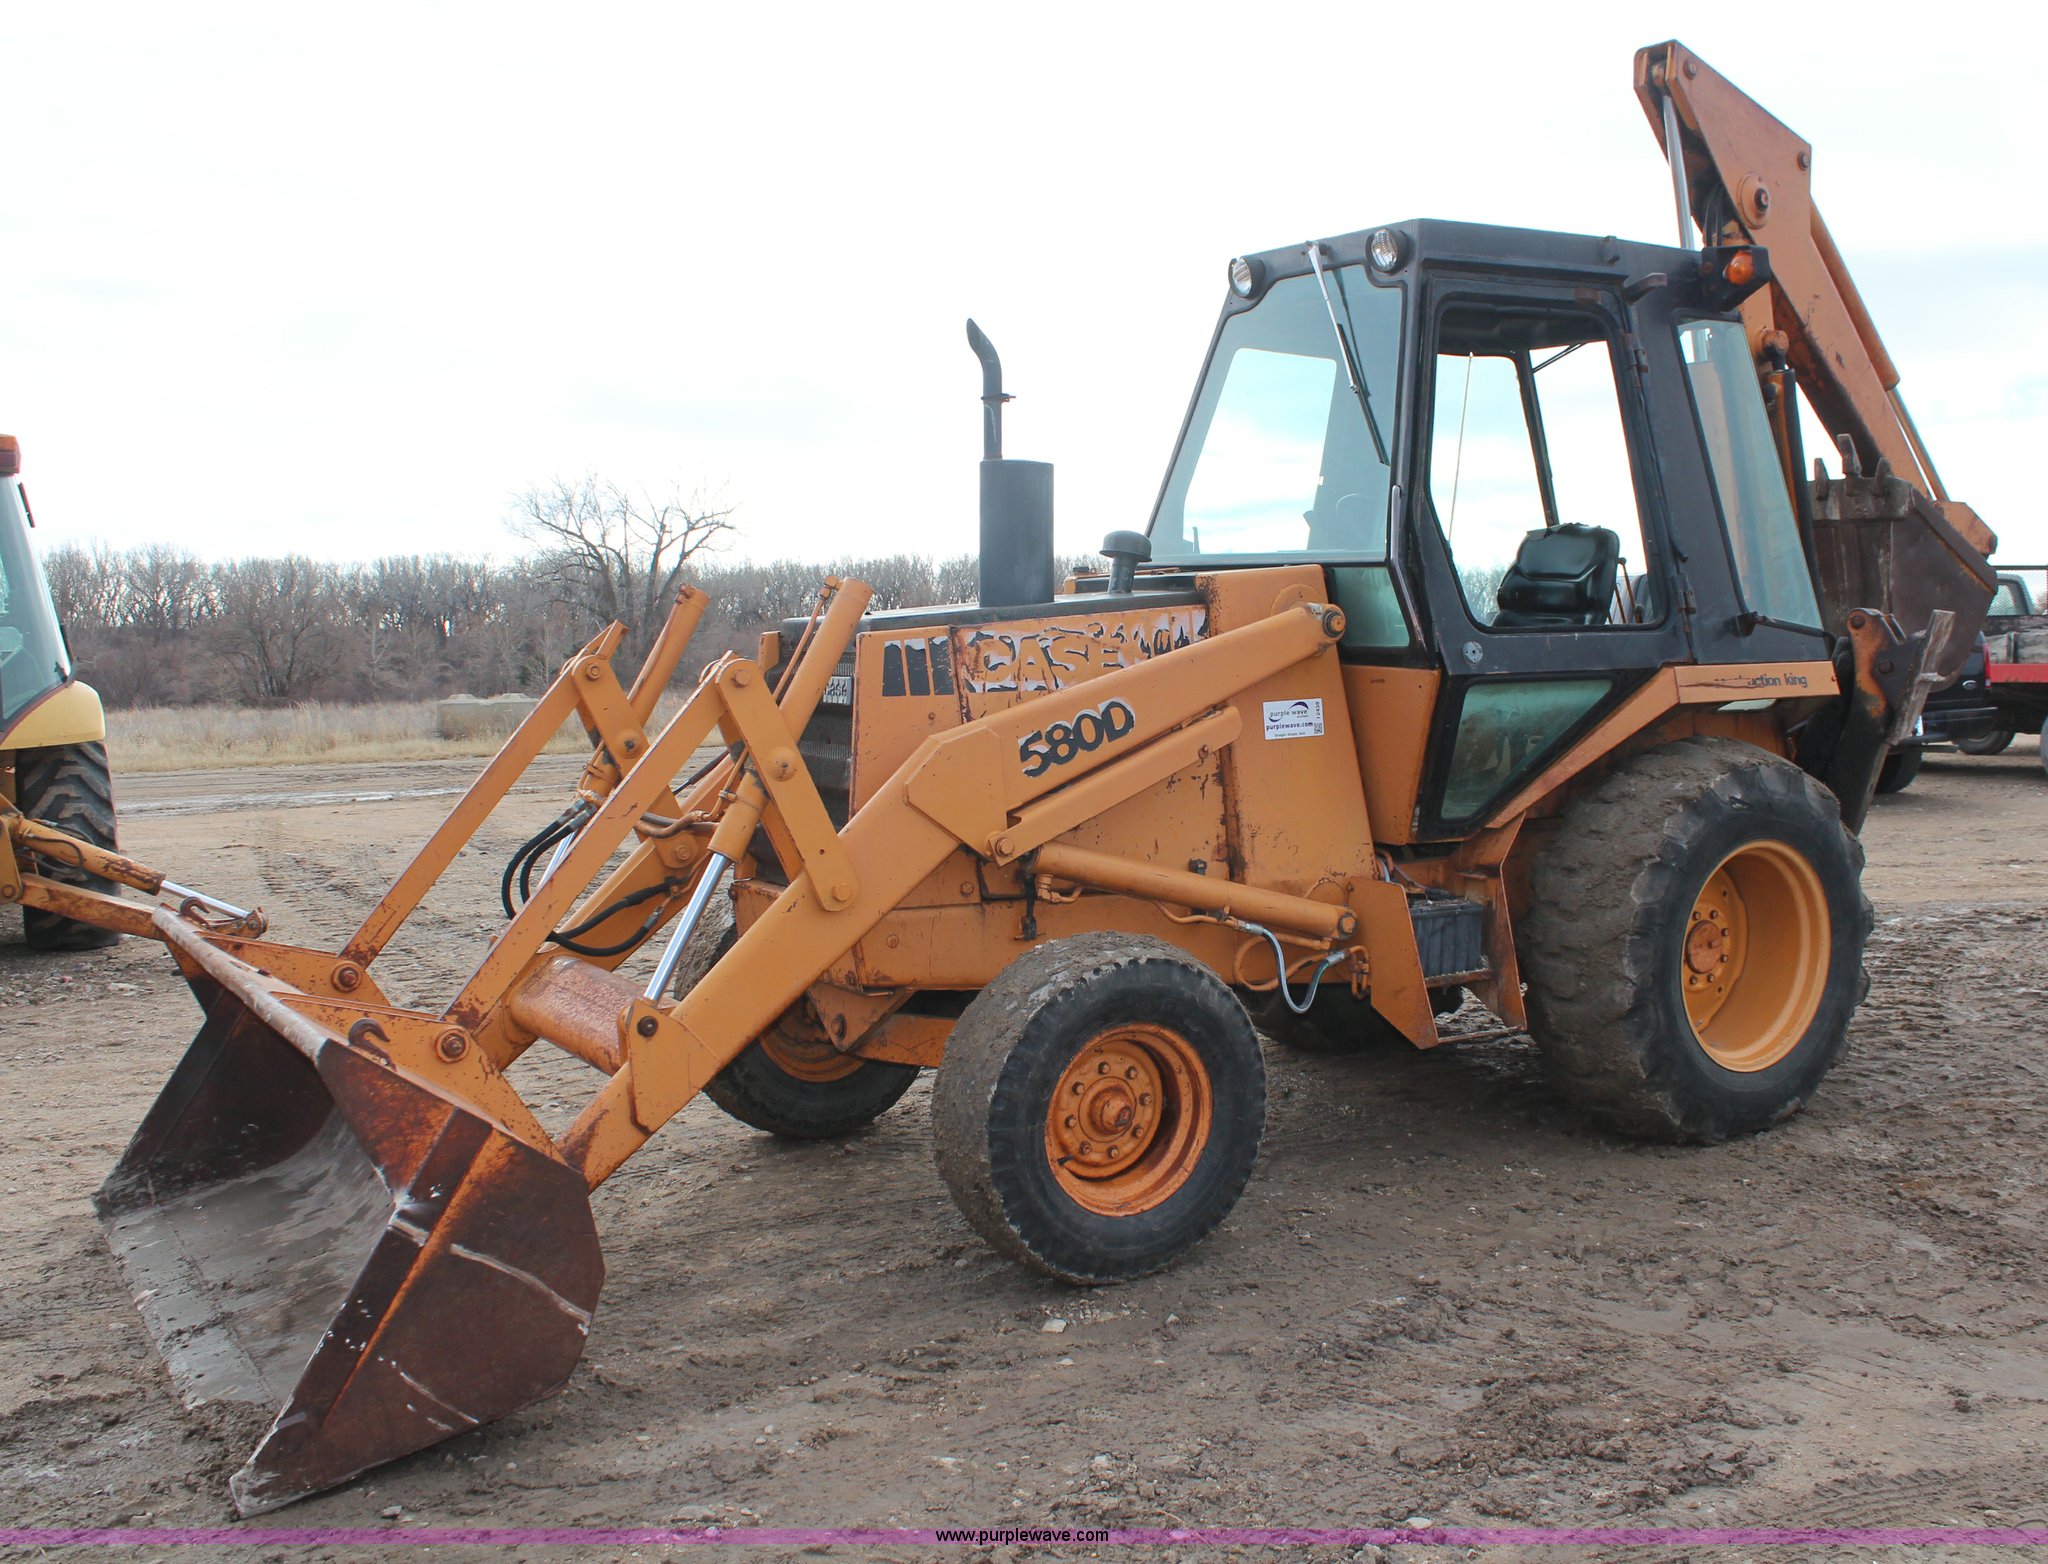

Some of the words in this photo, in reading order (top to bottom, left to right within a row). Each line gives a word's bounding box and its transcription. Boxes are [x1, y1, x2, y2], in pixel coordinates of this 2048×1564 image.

[1784, 672, 1808, 688] king
[1270, 710, 1290, 718] purple
[1266, 722, 1313, 731] purplewave.com
[1018, 697, 1136, 778] 580D
